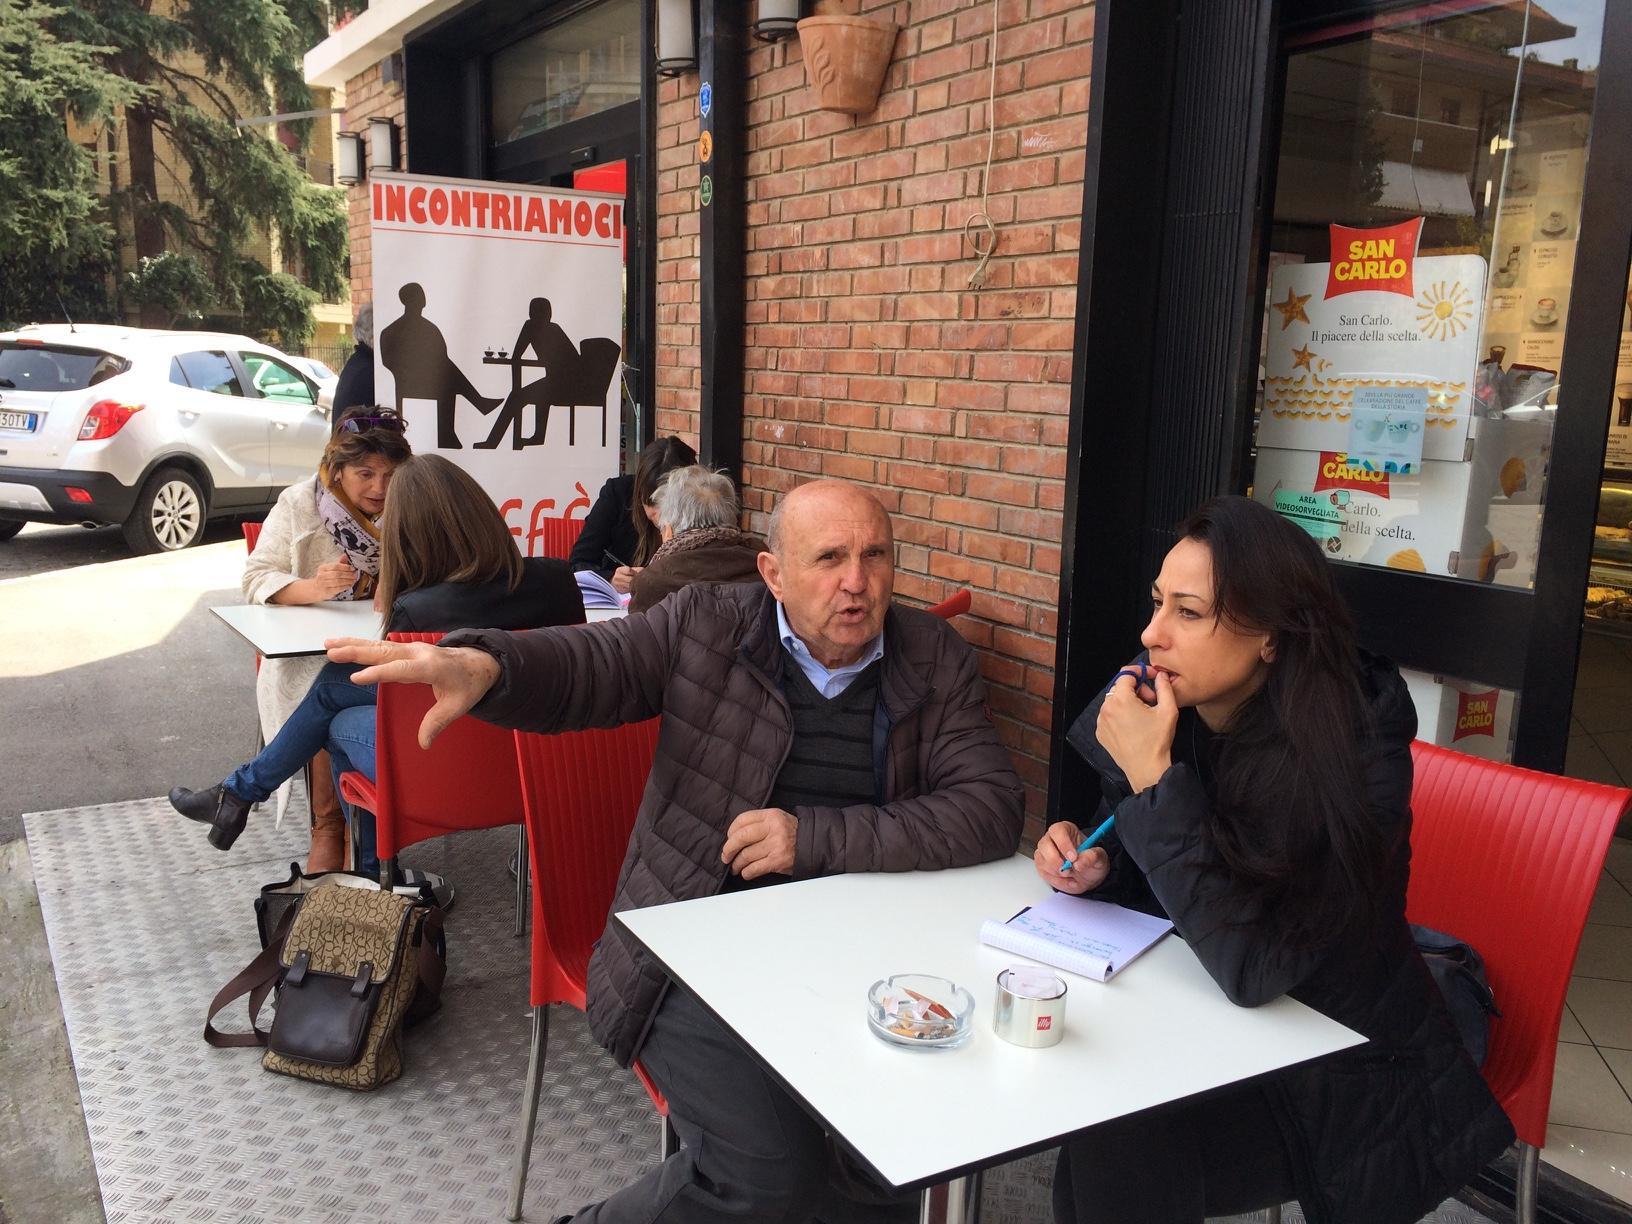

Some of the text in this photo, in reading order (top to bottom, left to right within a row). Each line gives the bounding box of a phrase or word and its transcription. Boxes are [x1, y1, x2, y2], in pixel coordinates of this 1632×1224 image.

[373, 184, 621, 239] INCONTRIAMOCI
[1349, 239, 1395, 260] SAN
[1334, 259, 1407, 281] CARLO
[1339, 314, 1393, 326] San Carlo.
[1321, 330, 1357, 344] piacere
[1360, 330, 1384, 341] della
[1387, 330, 1421, 341] scelta.
[0, 413, 27, 427] 30TV
[1299, 495, 1317, 505] AREA
[1275, 502, 1339, 519] VIDEOSORVEGLIATA
[1341, 520, 1371, 535] della
[1375, 525, 1416, 541] scelta.
[1467, 700, 1489, 715] SAN
[1458, 713, 1492, 729] CARLO
